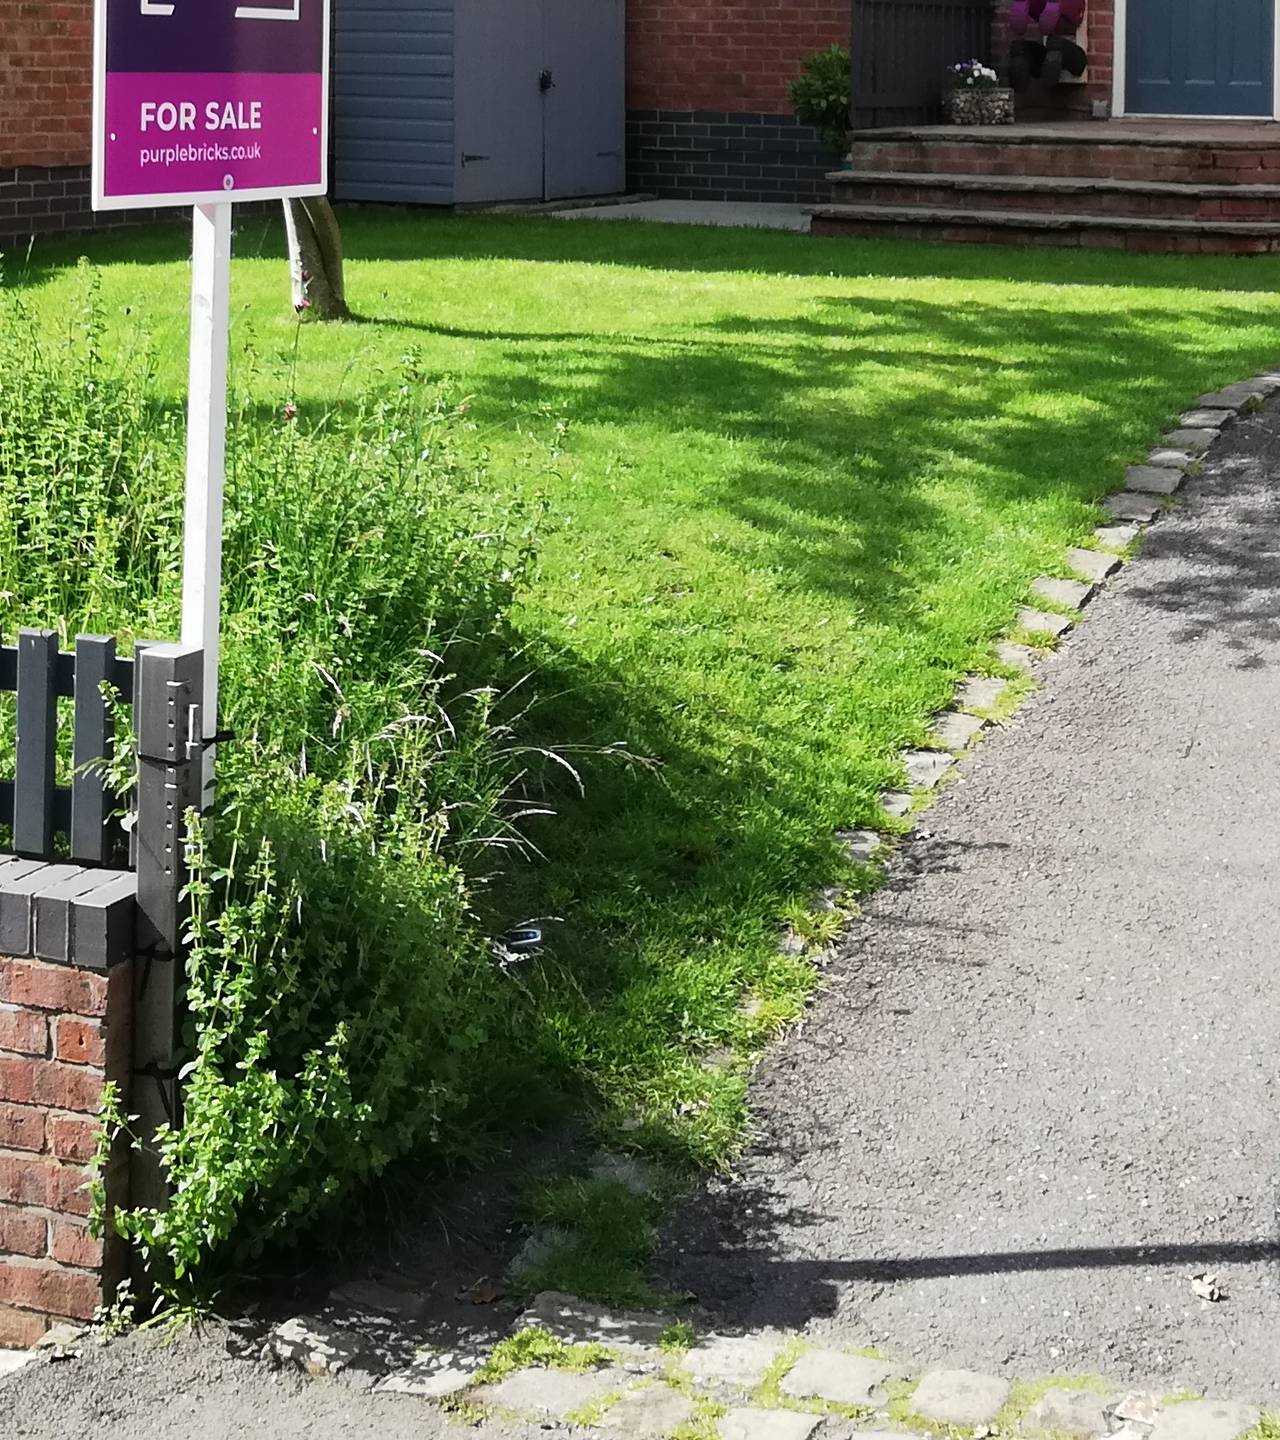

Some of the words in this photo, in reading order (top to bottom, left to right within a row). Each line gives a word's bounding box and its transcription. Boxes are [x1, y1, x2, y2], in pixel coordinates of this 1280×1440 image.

[140, 102, 197, 132] FOR
[205, 101, 262, 130] SALE
[140, 142, 261, 167] purplebricks.co.uk
